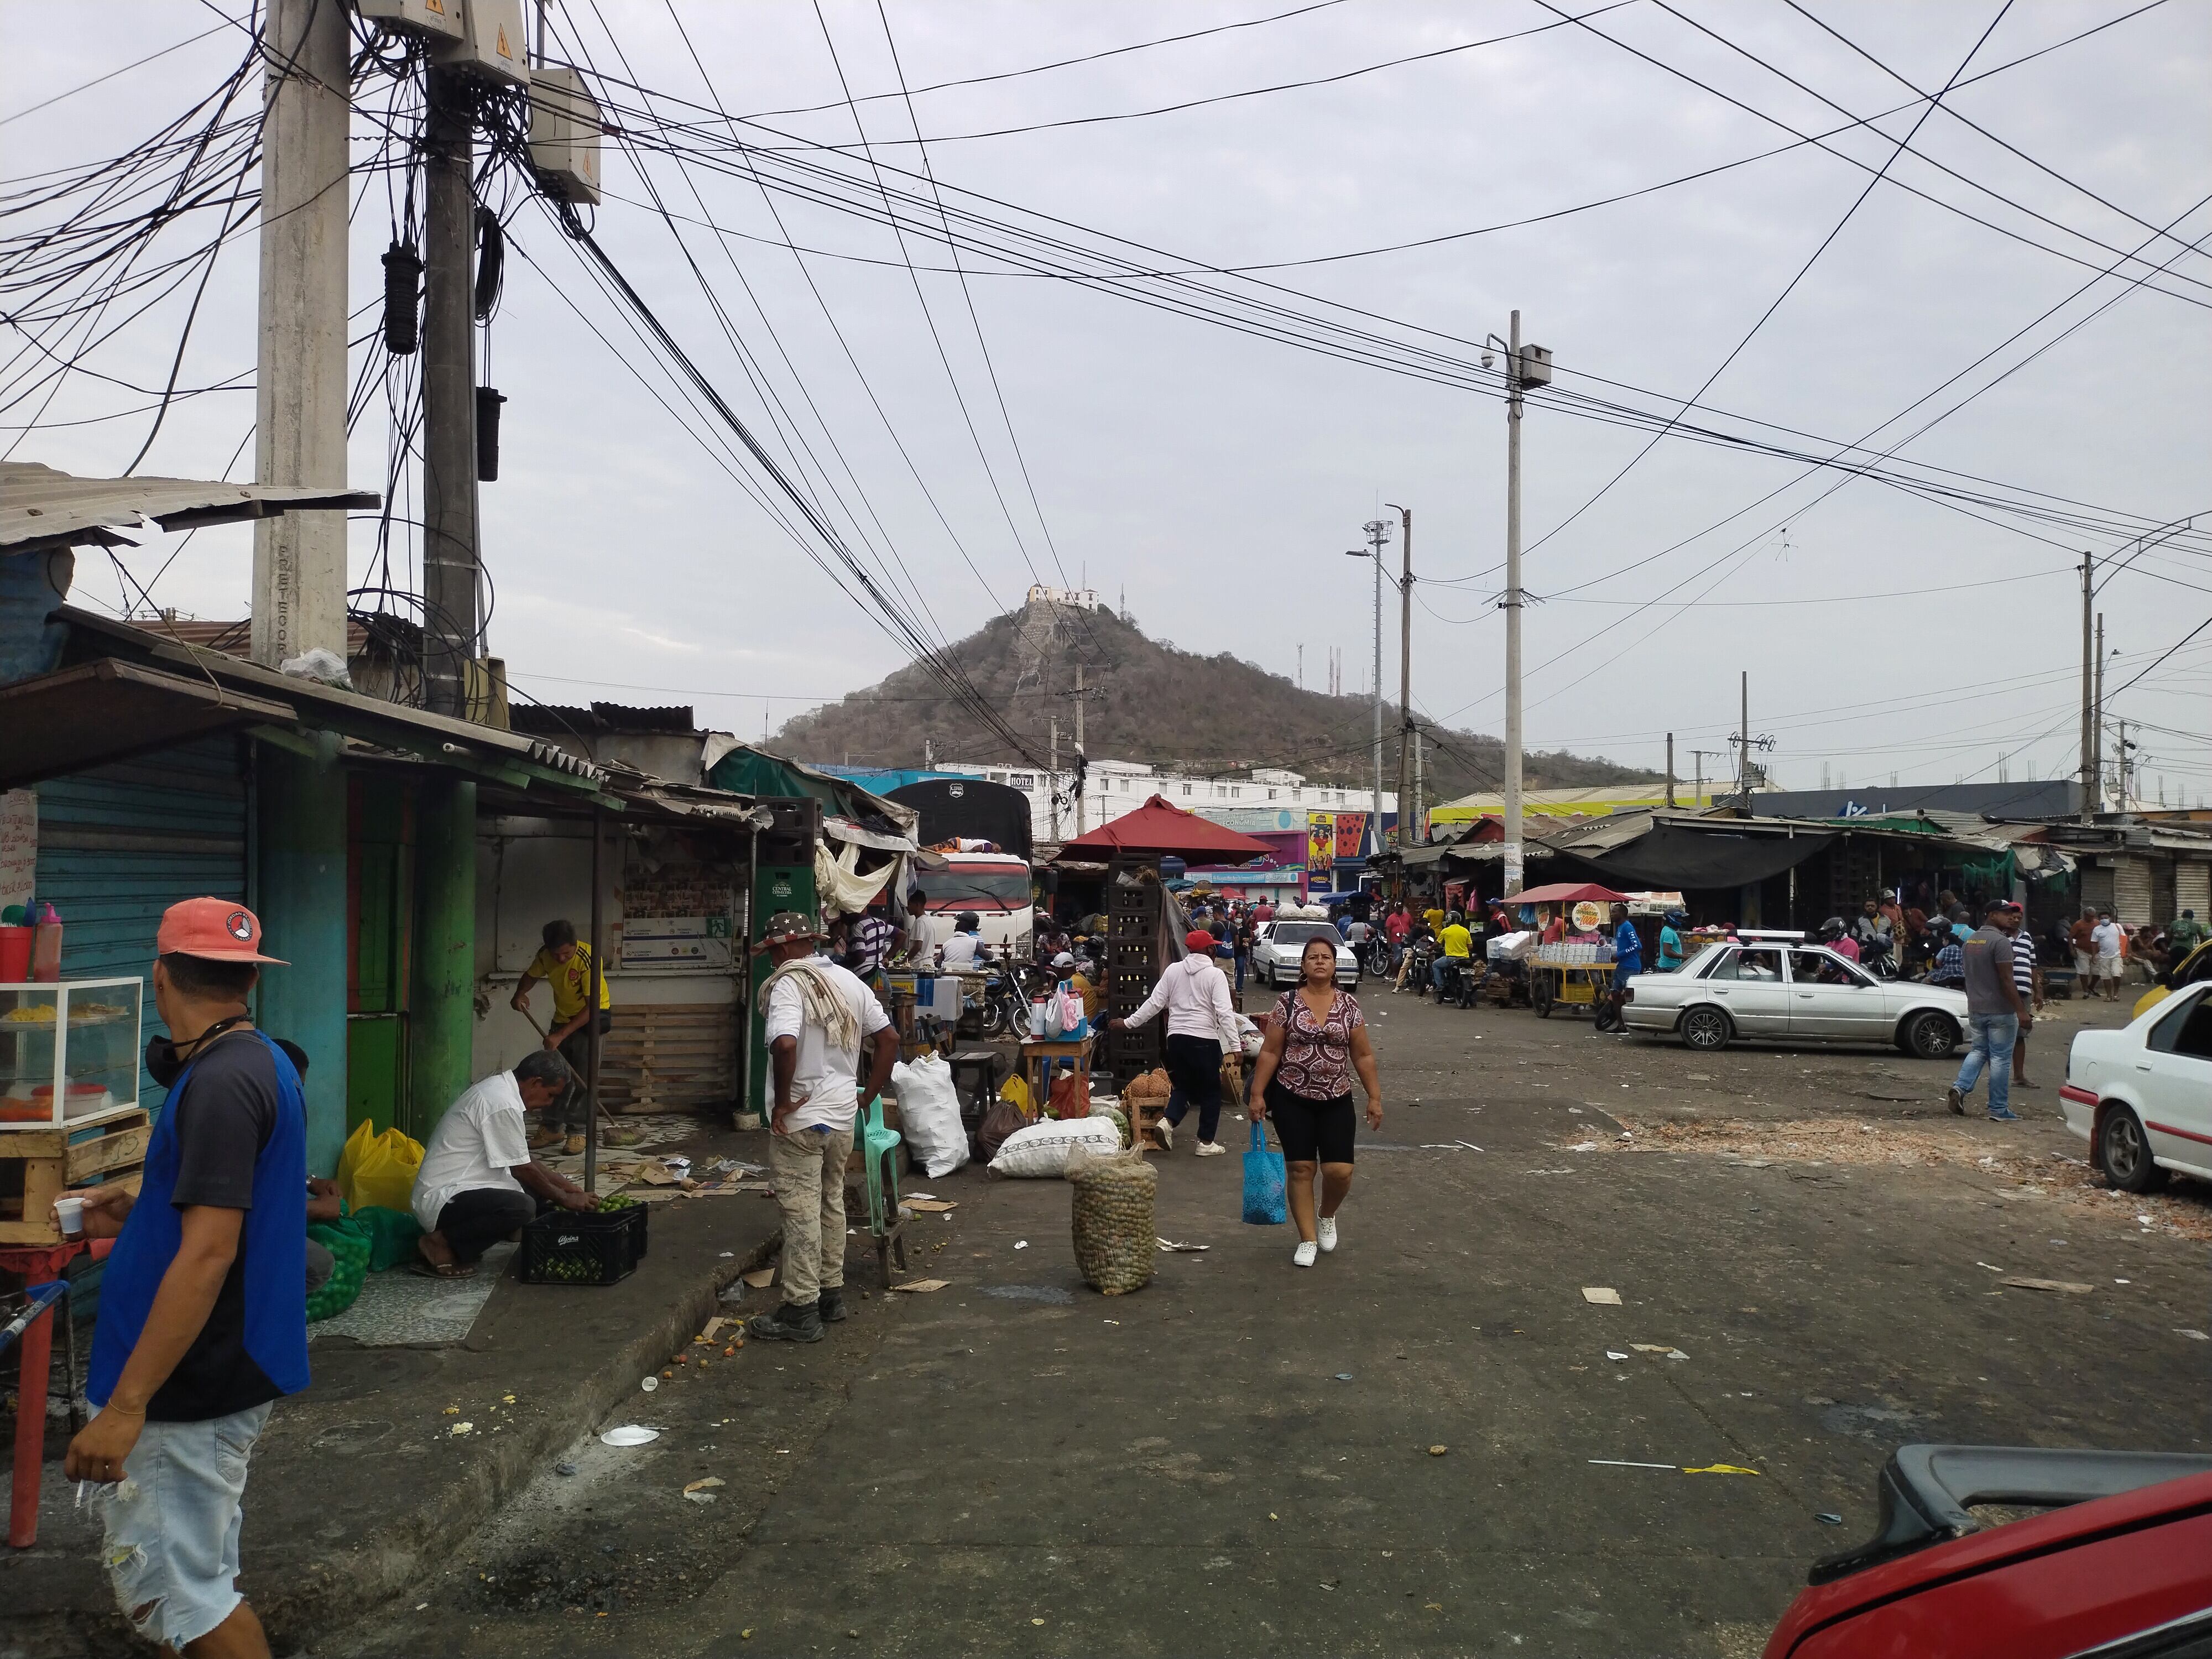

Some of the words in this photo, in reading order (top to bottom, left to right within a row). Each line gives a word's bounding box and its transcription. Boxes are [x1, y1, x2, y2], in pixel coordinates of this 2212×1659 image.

[1011, 777, 1034, 786] HOTEL
[227, 912, 242, 925] JORDAN
[558, 1235, 579, 1244] Alpina
